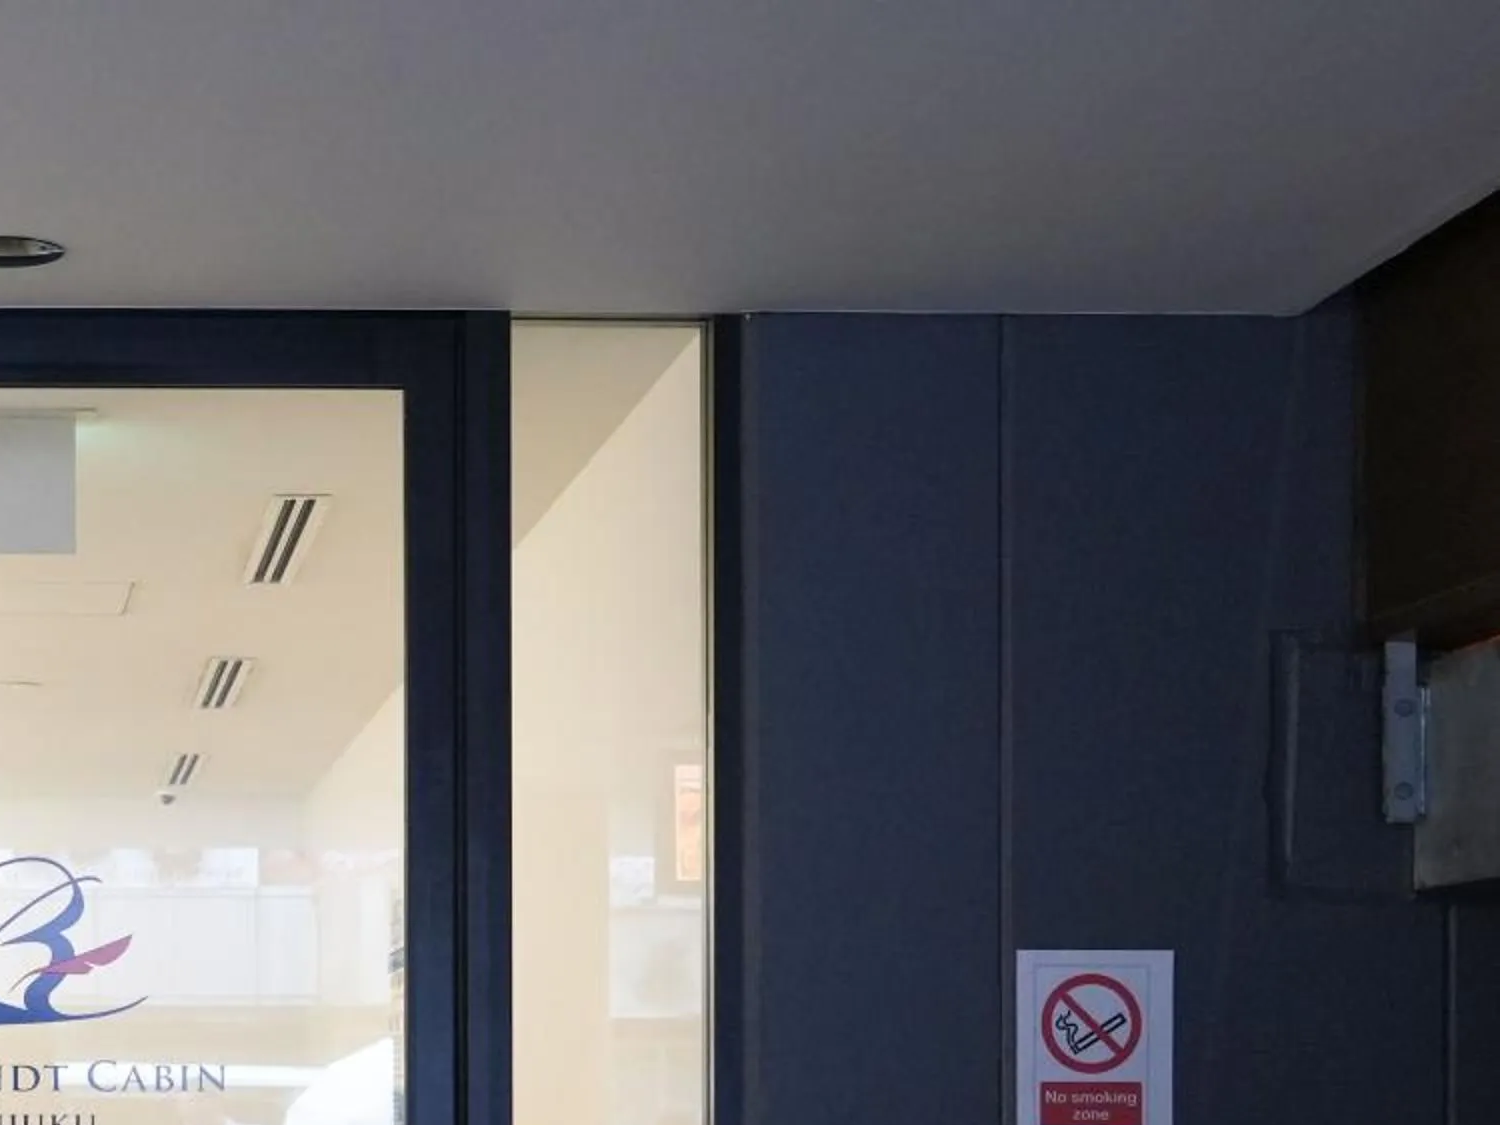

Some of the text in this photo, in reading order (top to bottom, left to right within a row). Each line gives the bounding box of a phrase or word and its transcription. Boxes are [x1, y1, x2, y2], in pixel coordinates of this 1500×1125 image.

[86, 1060, 227, 1093] CABIN
[1044, 1090, 1138, 1107] No smoking
[1072, 1109, 1109, 1121] zone
